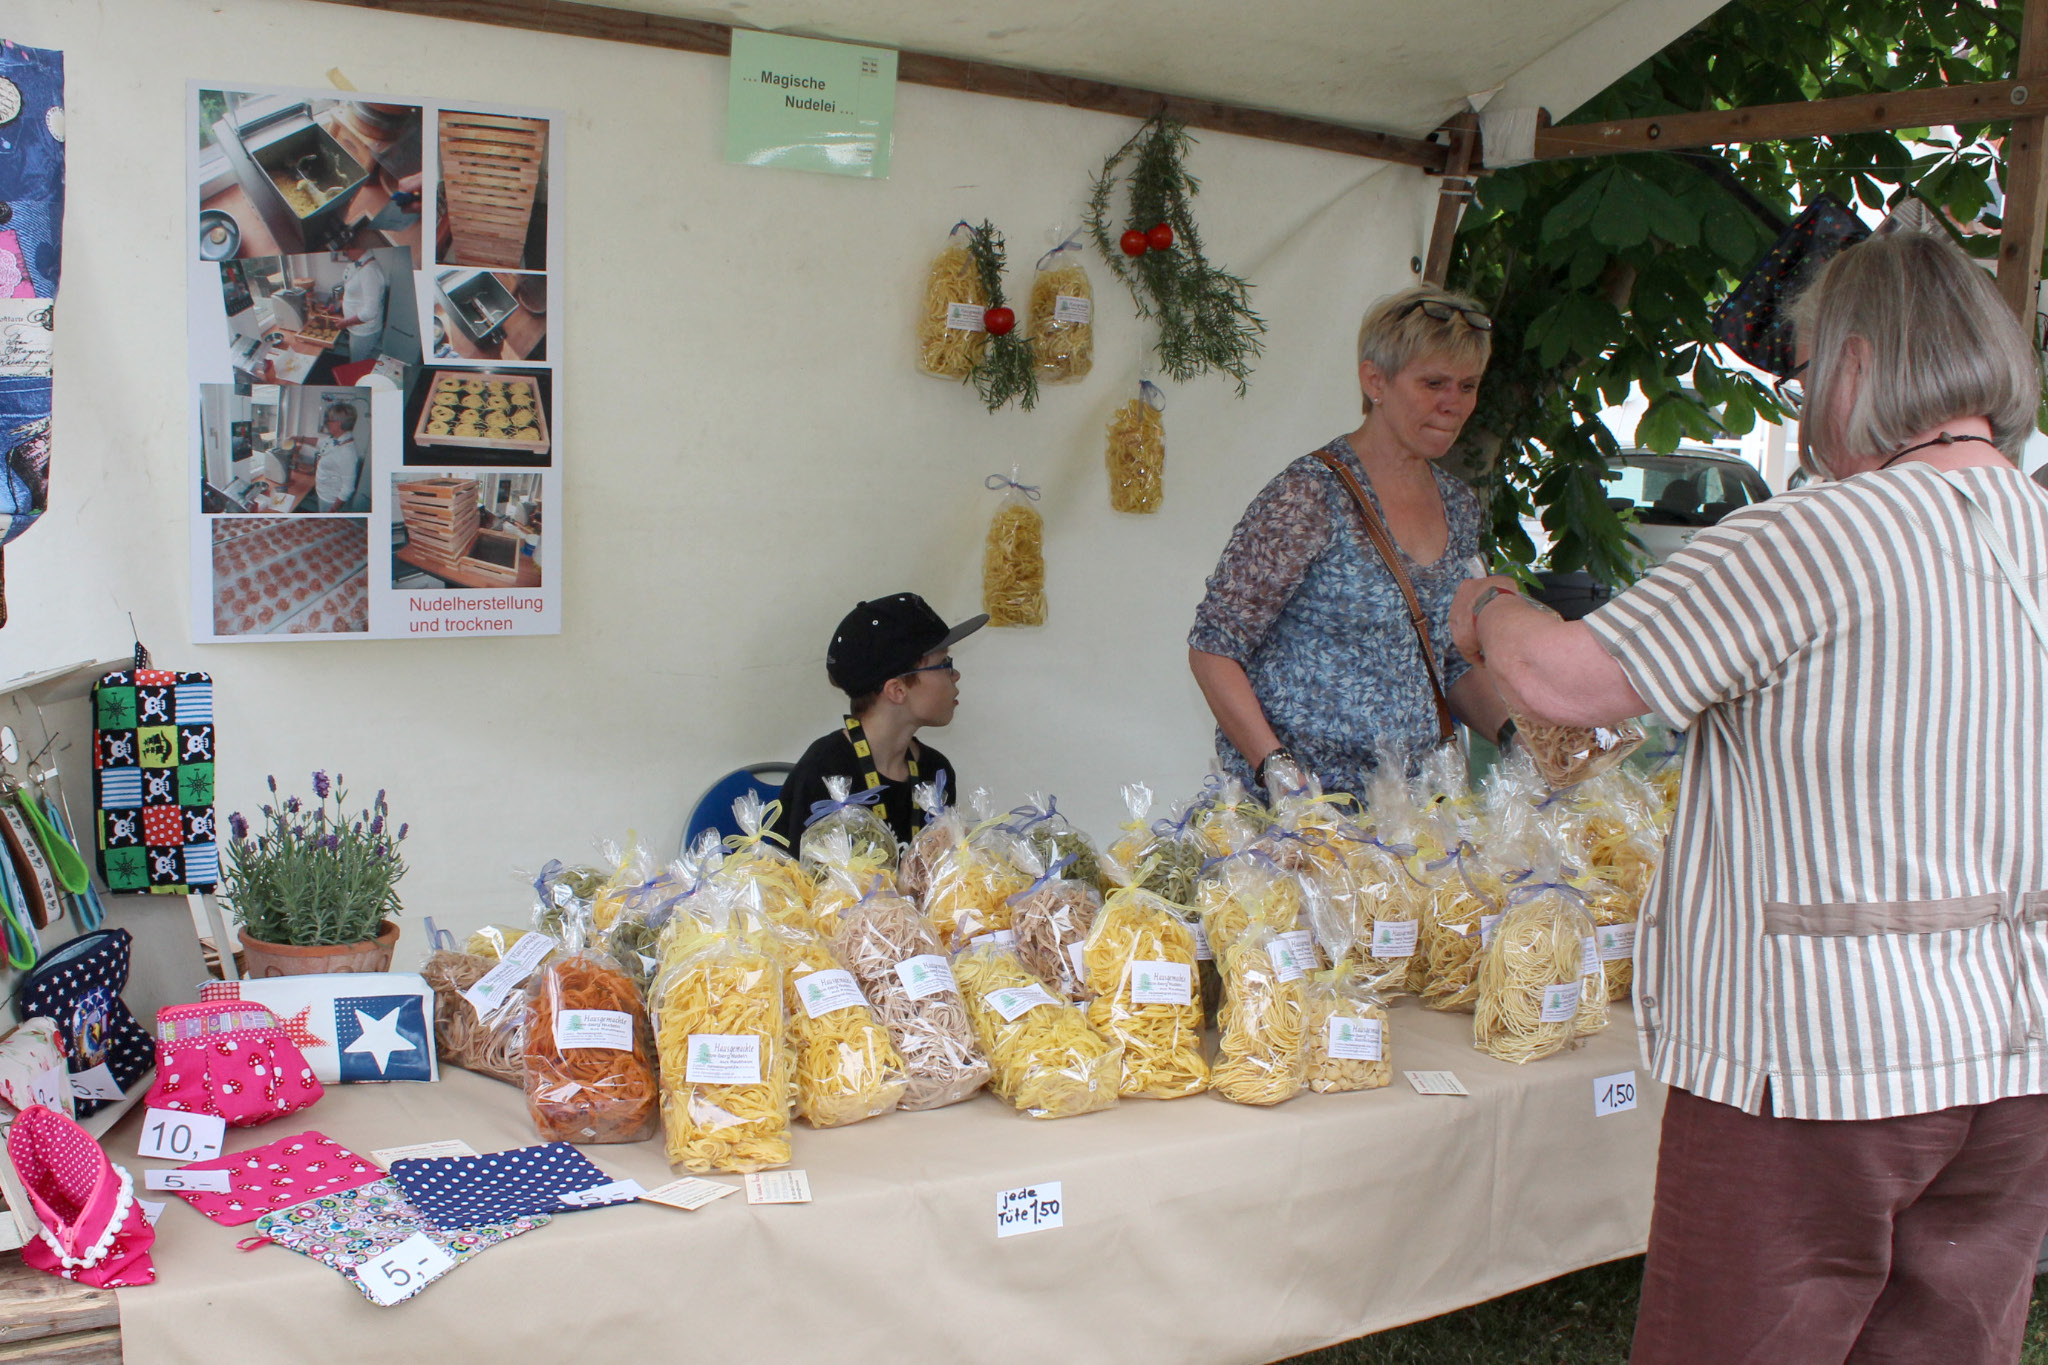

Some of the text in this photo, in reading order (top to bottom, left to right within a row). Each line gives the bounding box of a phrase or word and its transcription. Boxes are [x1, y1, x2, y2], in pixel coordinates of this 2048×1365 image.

[760, 70, 826, 90] Magische
[785, 95, 836, 113] Nudelei
[410, 596, 543, 613] Nudelherstellung
[410, 617, 513, 632] und trocknen
[714, 1042, 754, 1053] Hausgemachte
[152, 1121, 216, 1160] 10,-
[1003, 1187, 1037, 1210] jede
[998, 1207, 1028, 1226] Tüte
[381, 1257, 429, 1287] 5,-
